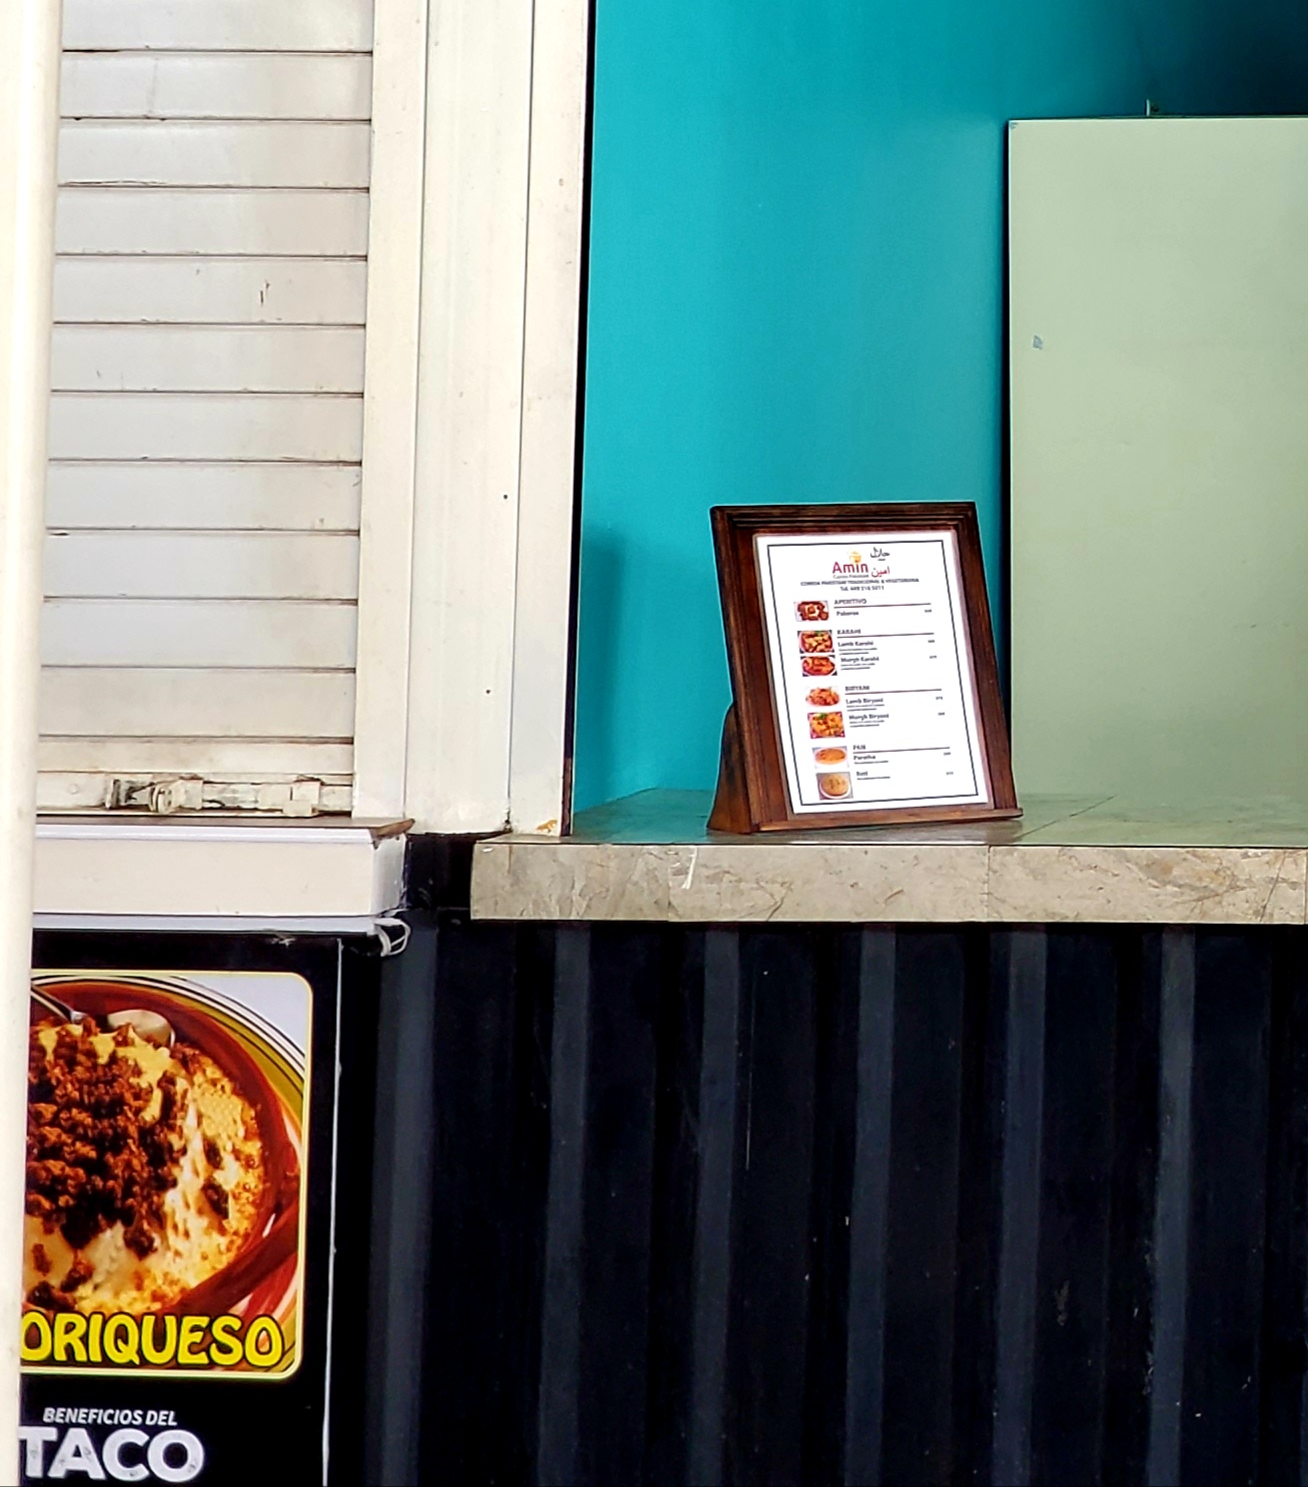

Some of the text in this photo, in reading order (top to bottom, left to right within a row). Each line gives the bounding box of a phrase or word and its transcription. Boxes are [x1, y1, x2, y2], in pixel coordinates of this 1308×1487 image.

[832, 560, 869, 574] Amin
[20, 1310, 284, 1367] ORIQUESO
[43, 1407, 178, 1426] BENEFICIOS DEL
[18, 1425, 205, 1483] TACO
